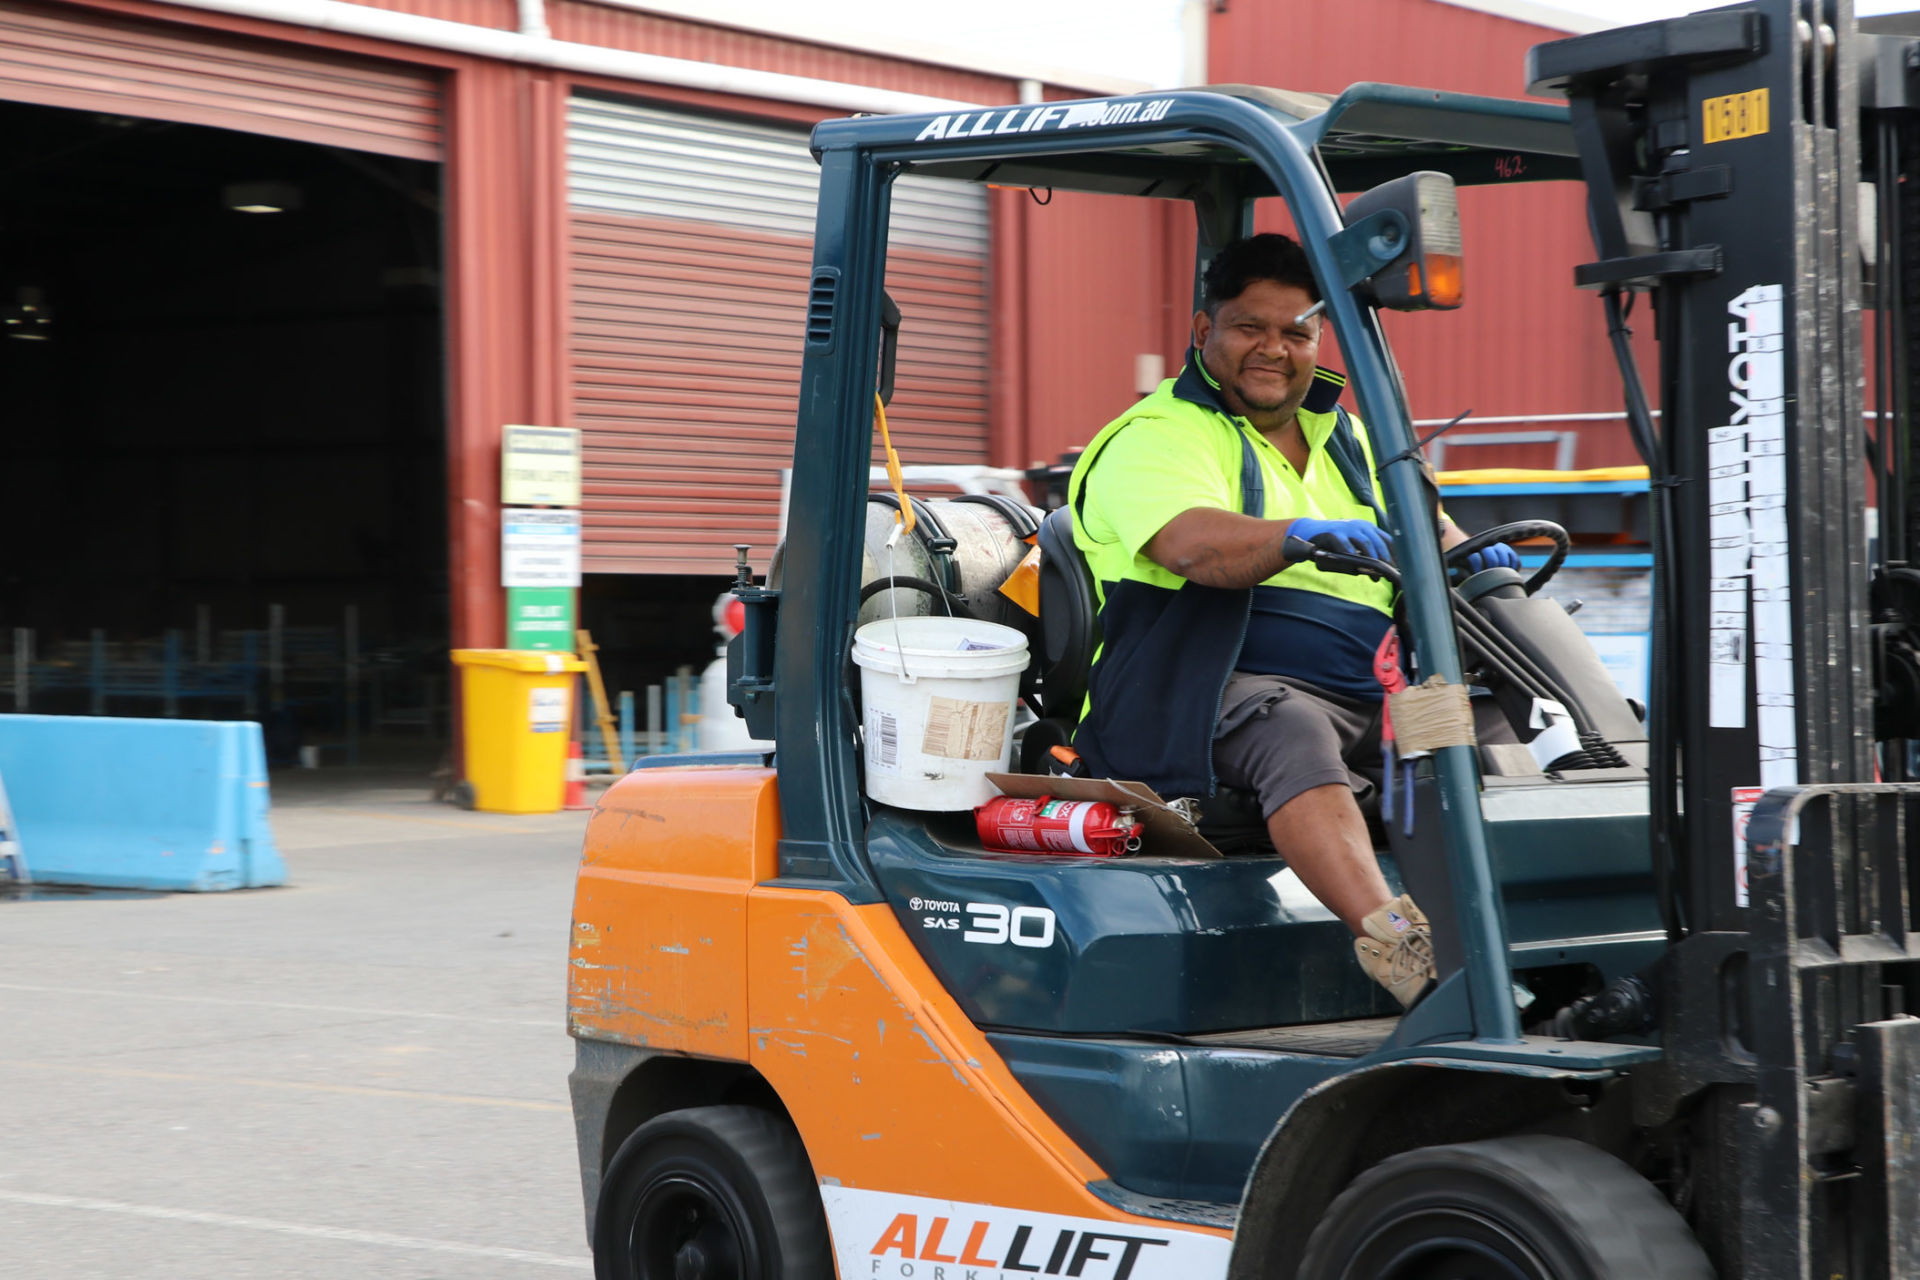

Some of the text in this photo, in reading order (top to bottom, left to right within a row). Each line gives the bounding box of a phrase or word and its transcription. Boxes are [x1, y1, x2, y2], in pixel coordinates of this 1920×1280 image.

[1706, 93, 1765, 141] 1581
[923, 917, 960, 930] SAS
[924, 899, 960, 913] TOYOTA
[964, 902, 1056, 948] 30
[869, 1212, 1170, 1280] ALLLIFT
